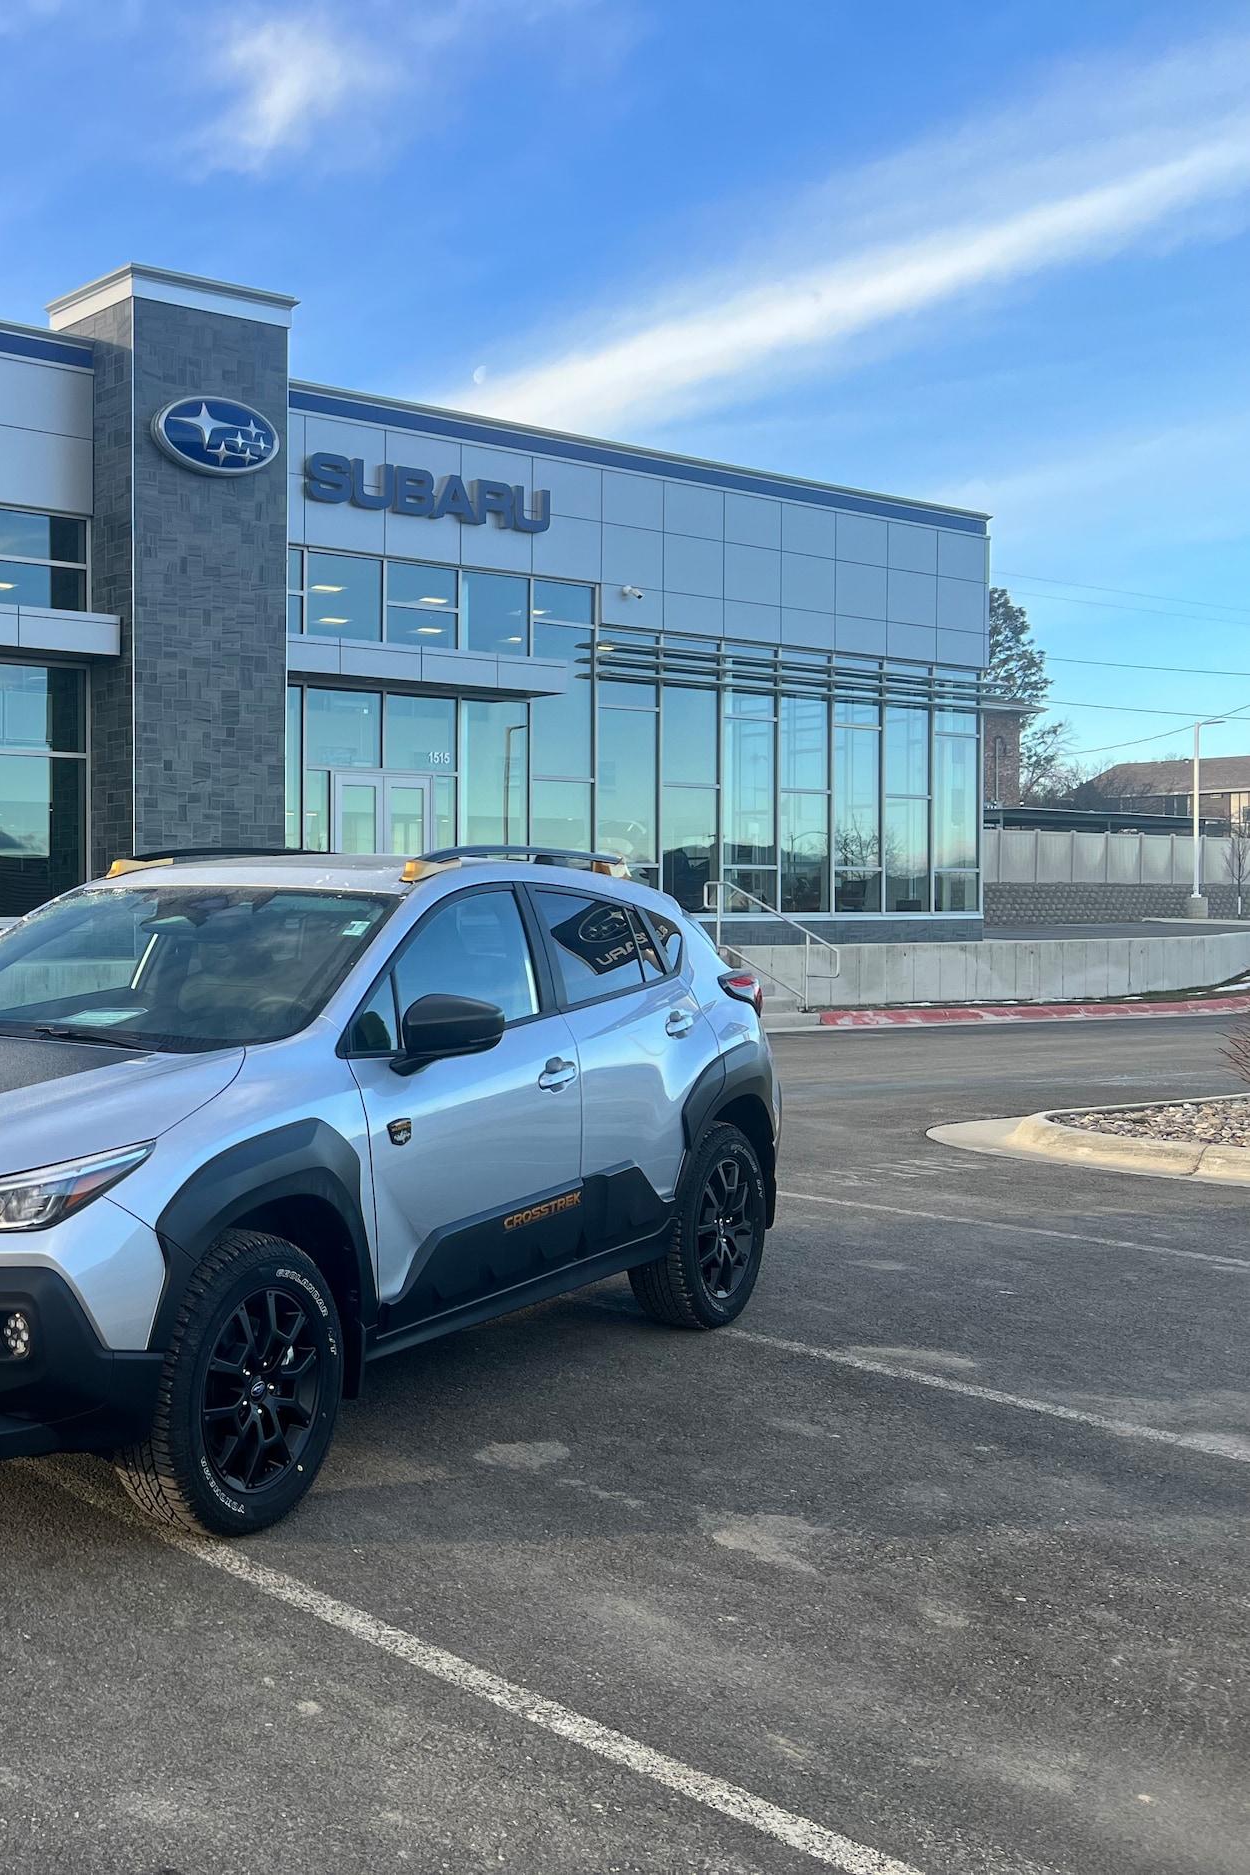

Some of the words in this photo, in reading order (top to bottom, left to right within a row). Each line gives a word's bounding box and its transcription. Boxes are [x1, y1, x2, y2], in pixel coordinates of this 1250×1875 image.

[304, 452, 551, 533] SUBARU
[428, 751, 450, 764] 1515
[503, 1191, 582, 1230] CROSSTREK
[275, 1268, 329, 1317] GEOLANDAR
